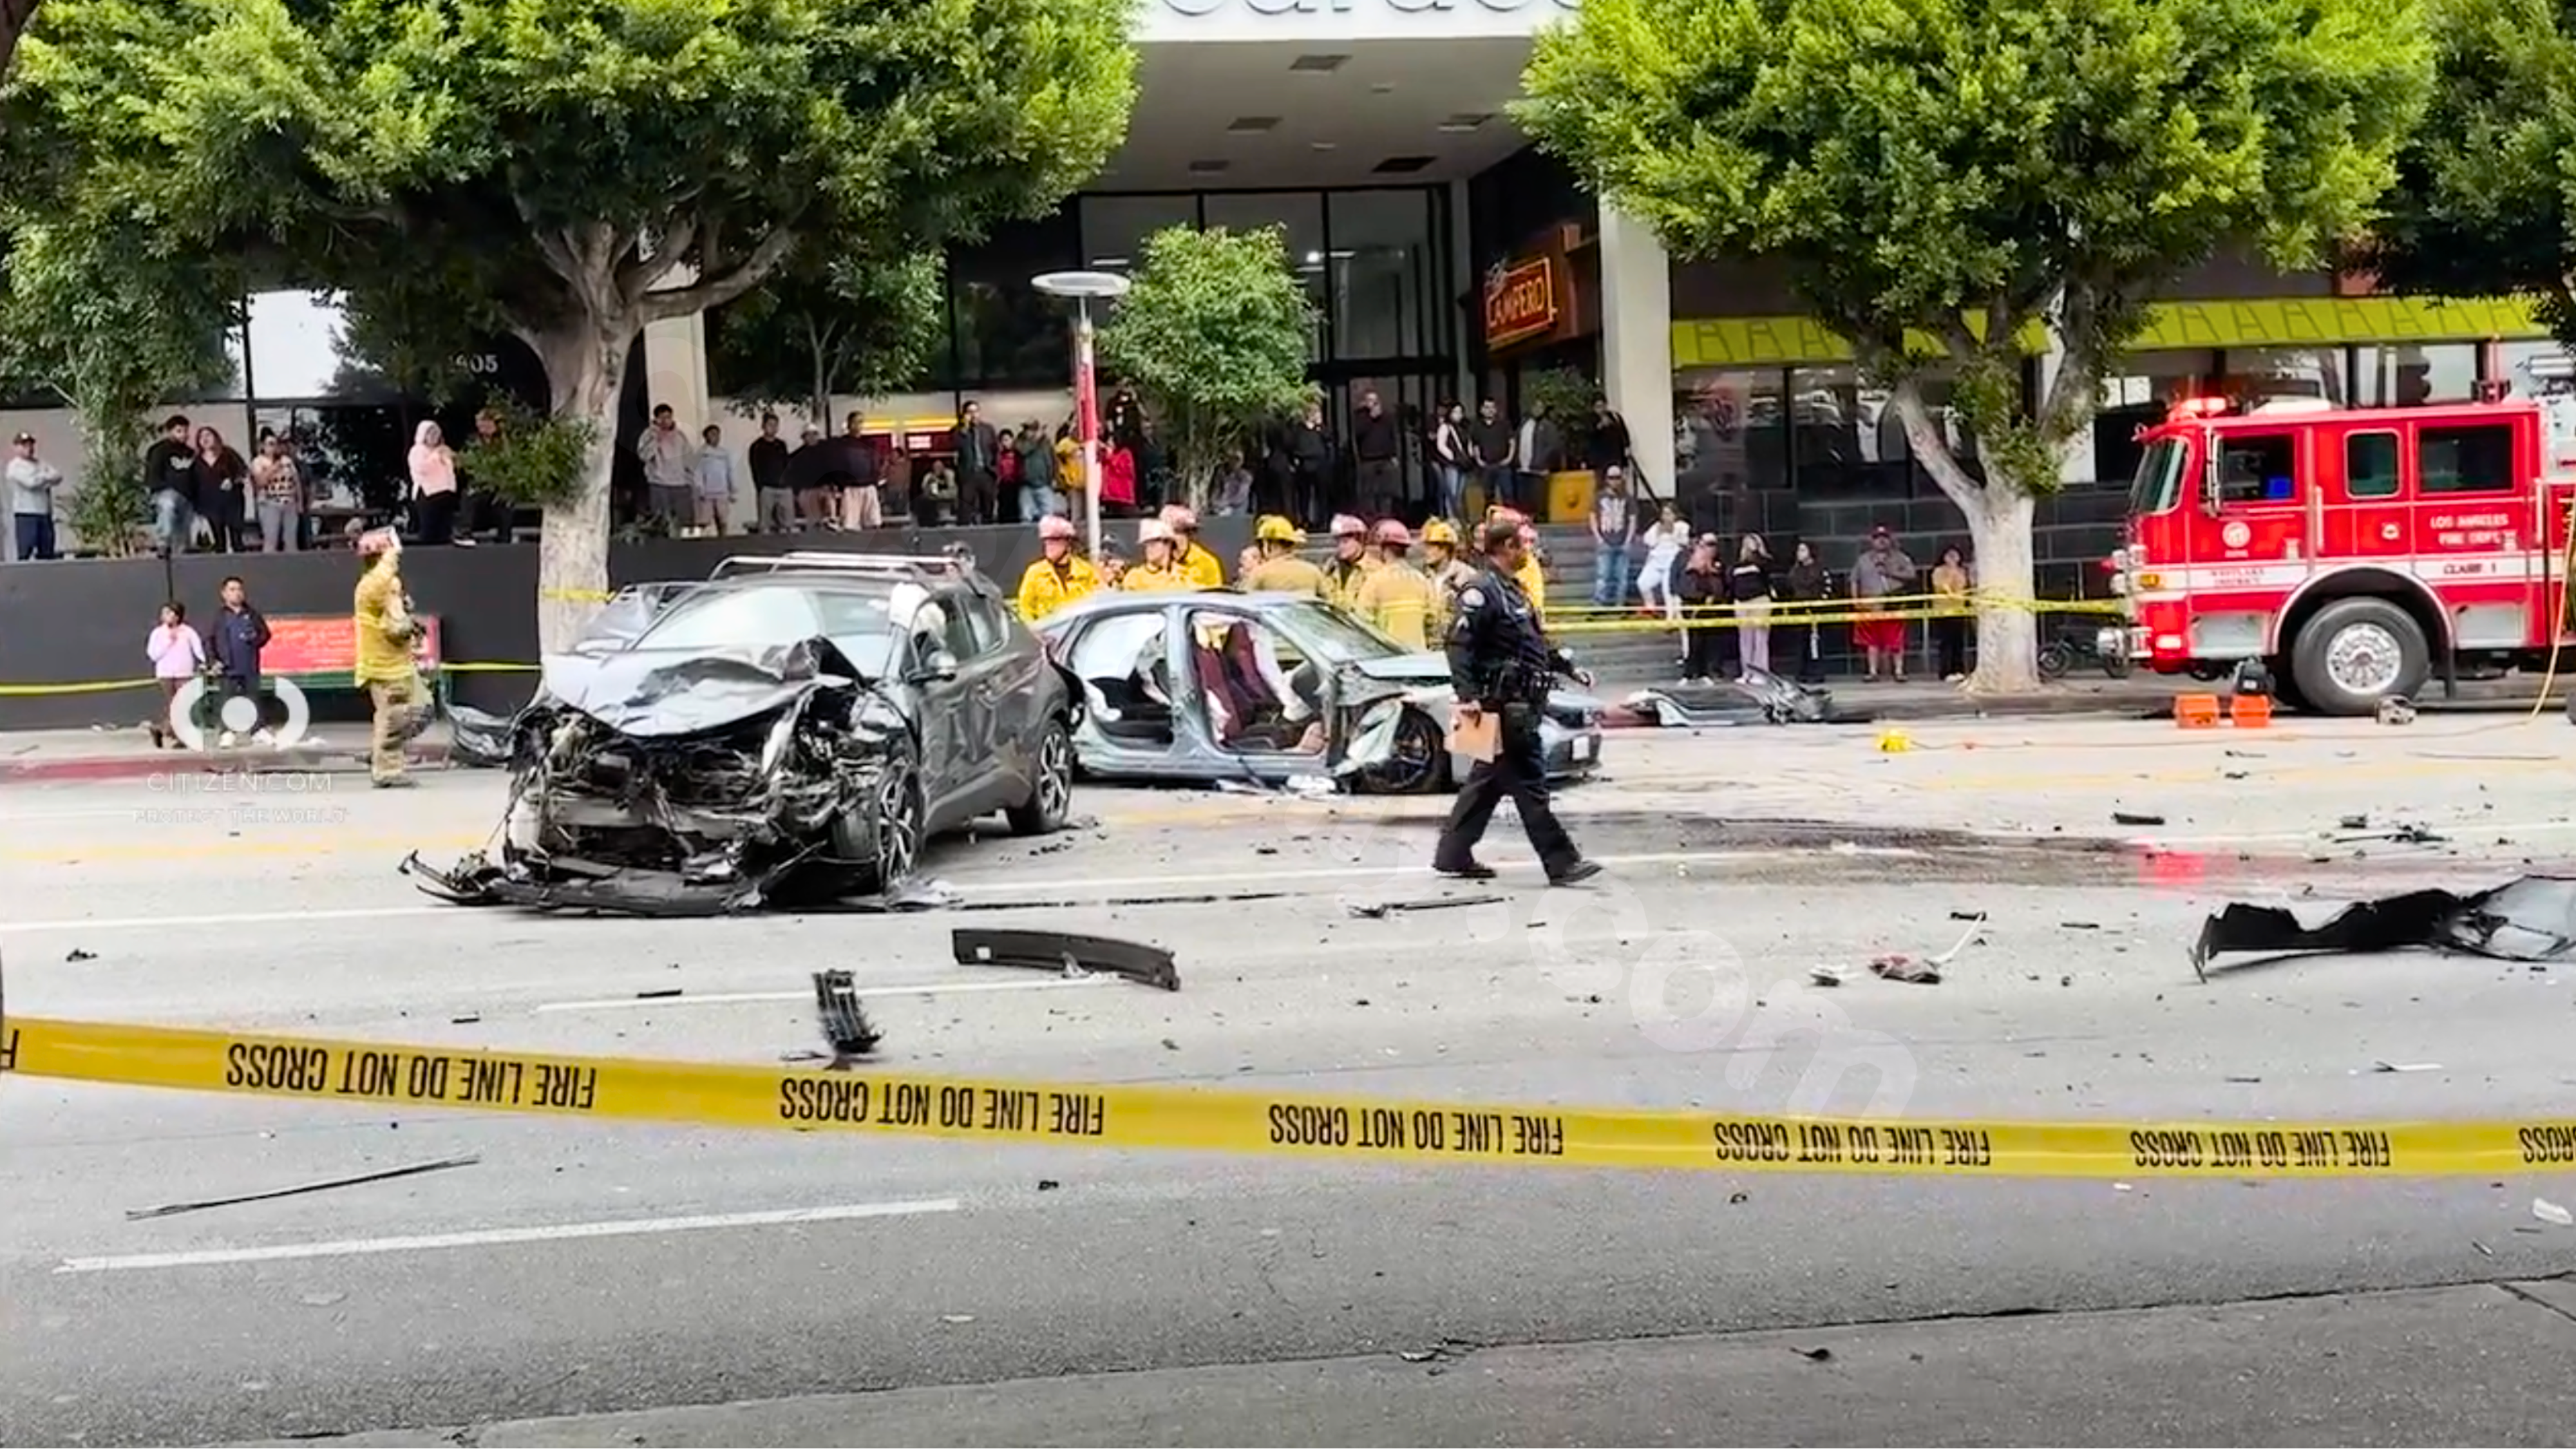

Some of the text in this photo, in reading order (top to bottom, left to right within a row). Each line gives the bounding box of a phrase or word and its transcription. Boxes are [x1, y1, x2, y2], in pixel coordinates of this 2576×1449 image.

[1487, 276, 1546, 328] CAMPERO
[2430, 513, 2510, 529] LOS ANGELES
[2438, 532, 2465, 546] FIRE
[227, 1043, 598, 1110] FIRE LINE DO NOT CROSS
[781, 1078, 1104, 1137] FIRE LINE DO NOT CROSS
[1269, 1104, 1564, 1157] FIRE LINE DO NOT CROSS
[1714, 1122, 1992, 1167] FIRE LINE DO NOT CROSS
[2130, 1131, 2391, 1168] FIRE LINE DO NOT CROSS
[2519, 1126, 2576, 1164] ROSS
